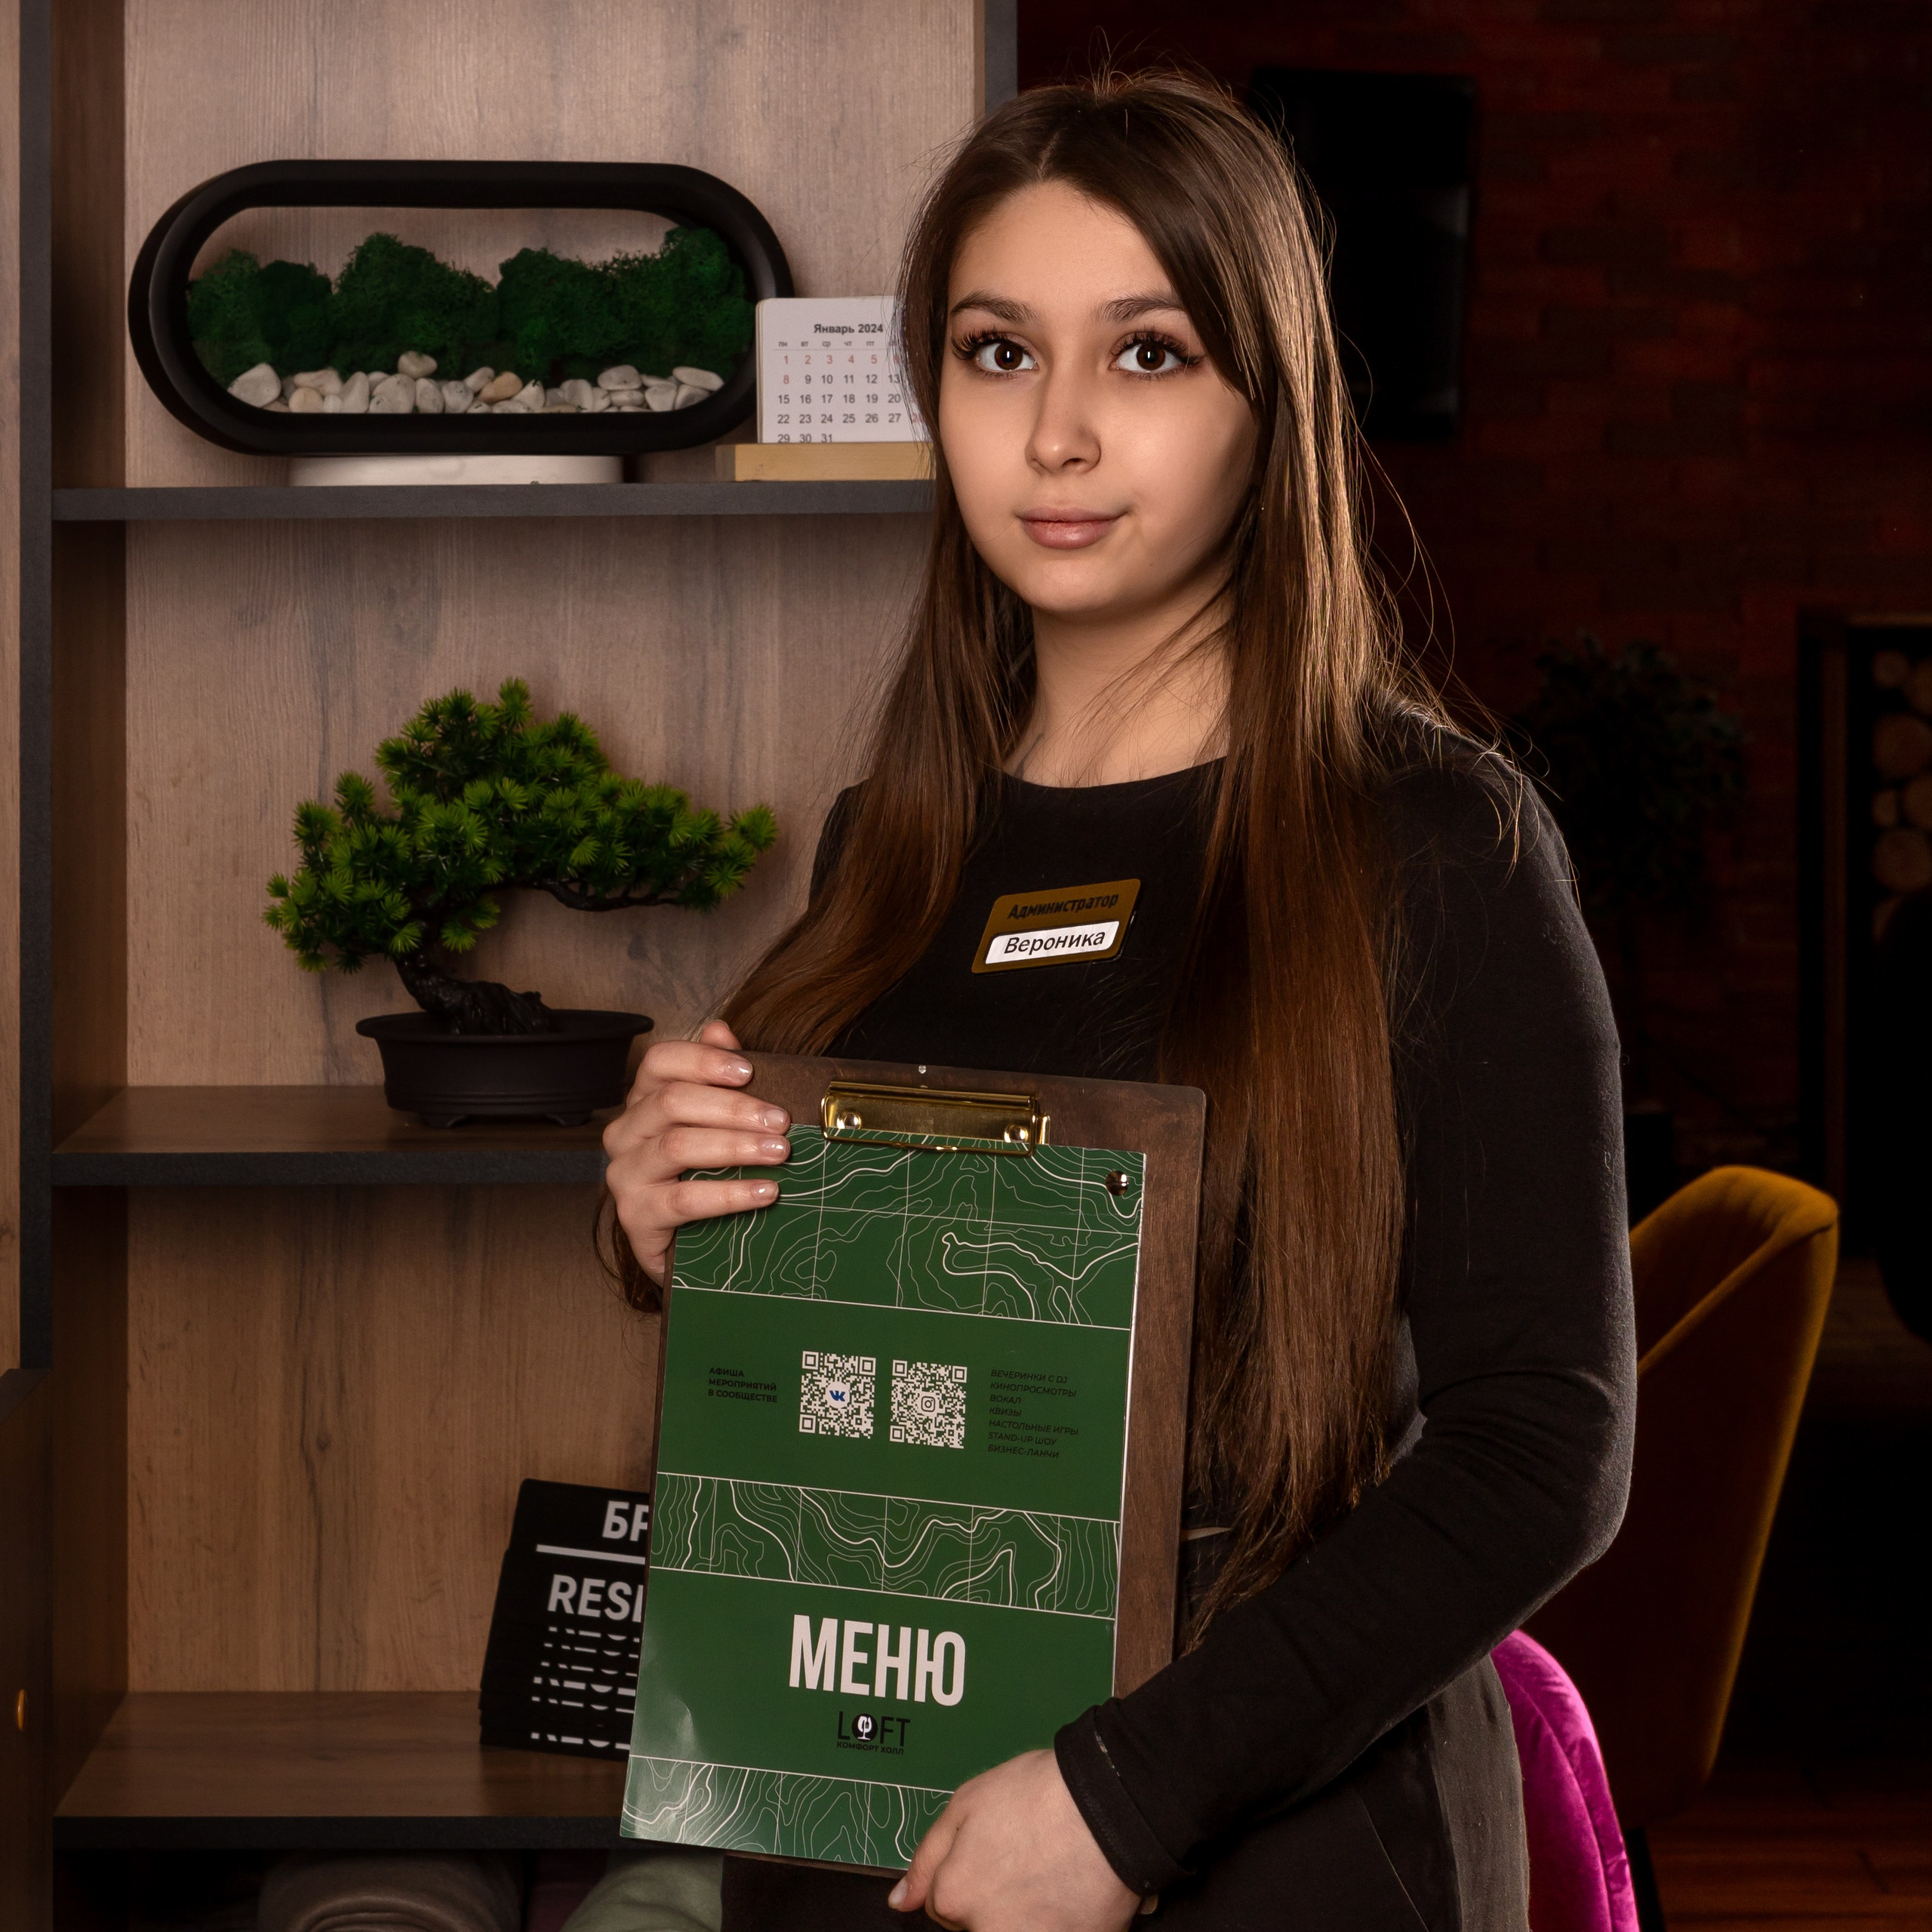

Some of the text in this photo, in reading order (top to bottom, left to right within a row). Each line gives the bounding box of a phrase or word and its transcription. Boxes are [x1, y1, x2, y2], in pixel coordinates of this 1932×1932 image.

[814, 324, 883, 335] Январь 2024
[783, 355, 789, 365] 1
[804, 355, 811, 365] 2
[826, 355, 832, 365] 3
[848, 355, 854, 364] 4
[870, 354, 877, 364] 5
[783, 374, 900, 384] 8 9 10 11 12 13
[777, 394, 789, 405] 15
[799, 394, 811, 404] 16
[821, 394, 832, 404] 17
[843, 394, 855, 404] 18
[866, 394, 878, 404] 19
[888, 393, 901, 403] 20
[777, 414, 789, 424] 22
[799, 414, 811, 423] 23
[820, 414, 833, 423] 24
[842, 414, 855, 423] 25
[865, 414, 878, 423] 26
[888, 414, 901, 423] 27
[777, 434, 832, 443] 29 30 31
[1007, 894, 1119, 920] Администратор
[1004, 931, 1106, 955] Вероника
[709, 1367, 745, 1377] АФИША
[990, 1369, 1046, 1381] ВЕЧЕРИНКИ
[709, 1378, 777, 1391] МЕРОПРИЯТИЙ
[990, 1382, 1077, 1397] КИНОПРОСМОТРЫ
[716, 1390, 777, 1402] СООБЩЕСТВЕ
[989, 1394, 1021, 1404] ВОКАЛ
[989, 1407, 1021, 1417] КВИЗЫ
[988, 1420, 1078, 1435] НАСТОЛЬНЫЕ ИГРЫ
[988, 1432, 1057, 1446] STAND-UP ШОУ
[987, 1444, 1060, 1459] БИЗНЕС-ЛАНЧИ
[789, 1614, 966, 1706] МЕНЮ
[838, 1711, 911, 1747] LOFT
[836, 1740, 904, 1755] КОМФОРТ ХОЛЛ
